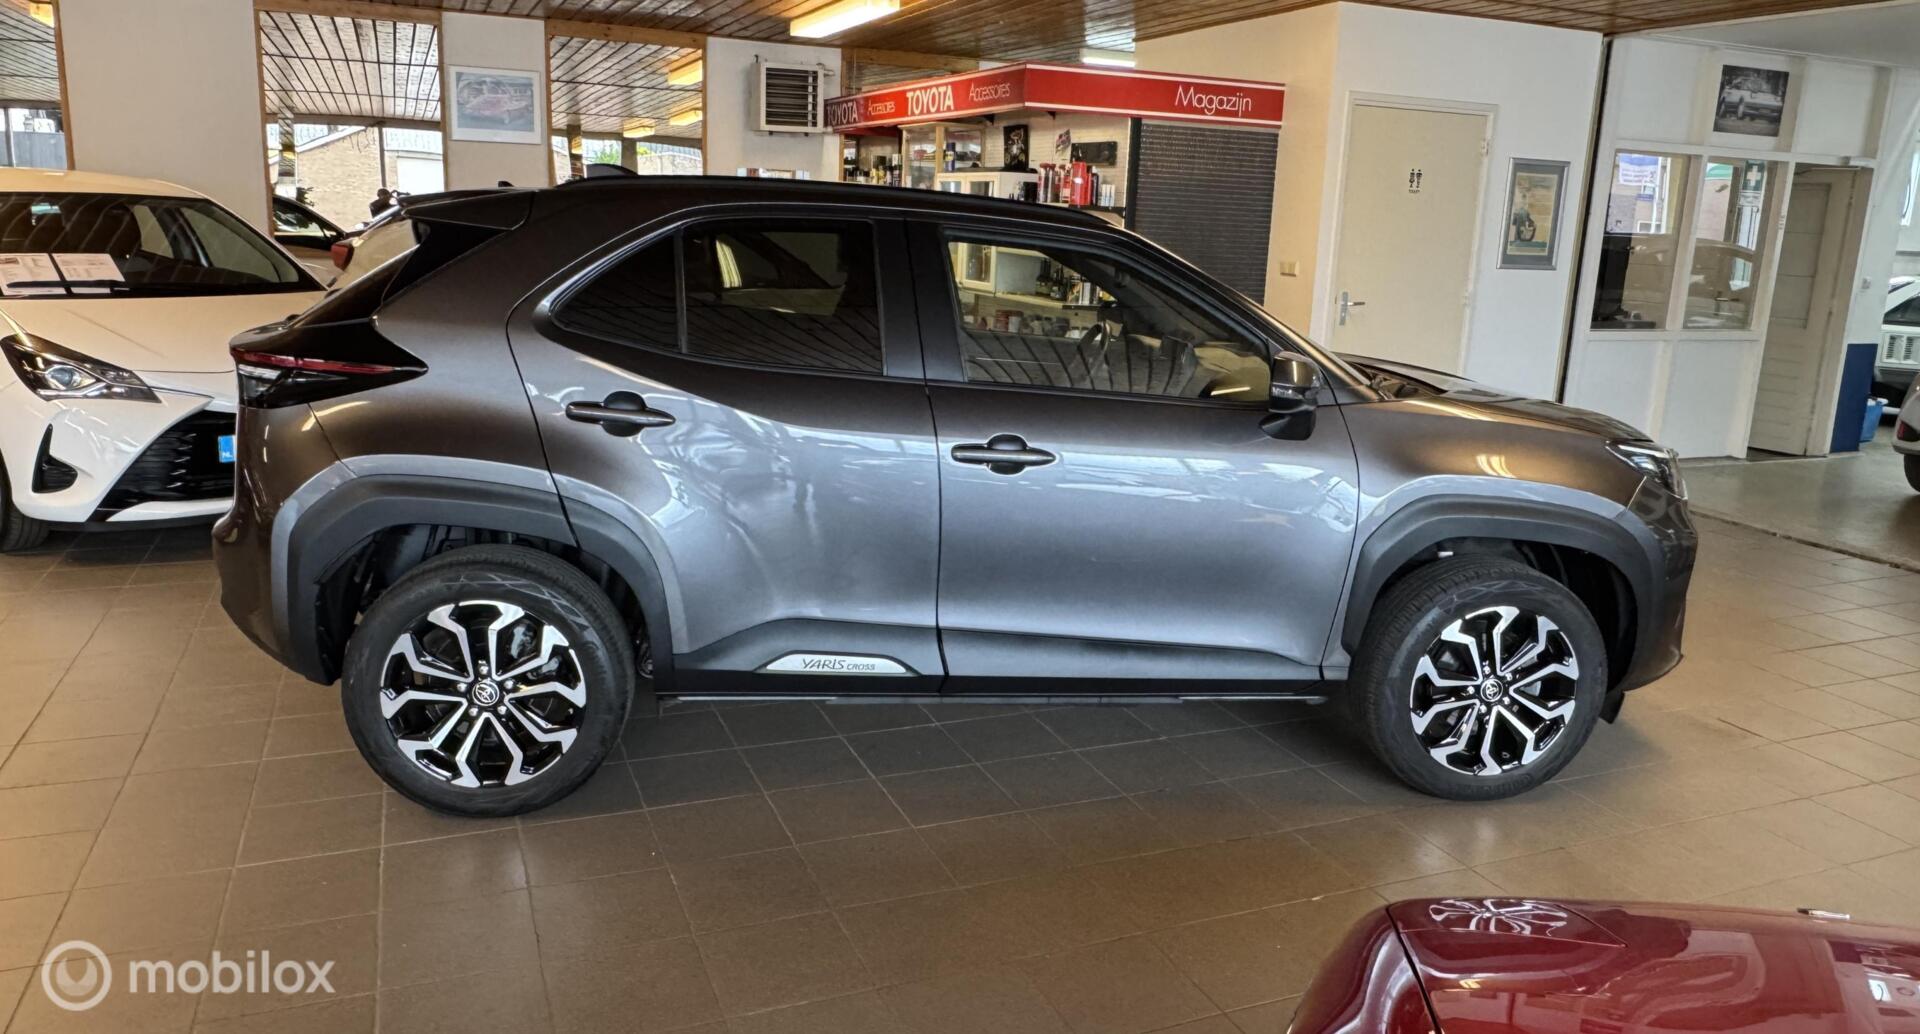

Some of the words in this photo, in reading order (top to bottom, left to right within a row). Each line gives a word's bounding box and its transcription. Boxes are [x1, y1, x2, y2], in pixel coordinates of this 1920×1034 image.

[827, 101, 859, 126] TOYOTA
[906, 86, 954, 116] TOYOTA
[969, 82, 1011, 102] Accessoires
[1175, 84, 1252, 117] Magazijn
[802, 658, 846, 670] YARIS
[846, 663, 876, 671] CROSS
